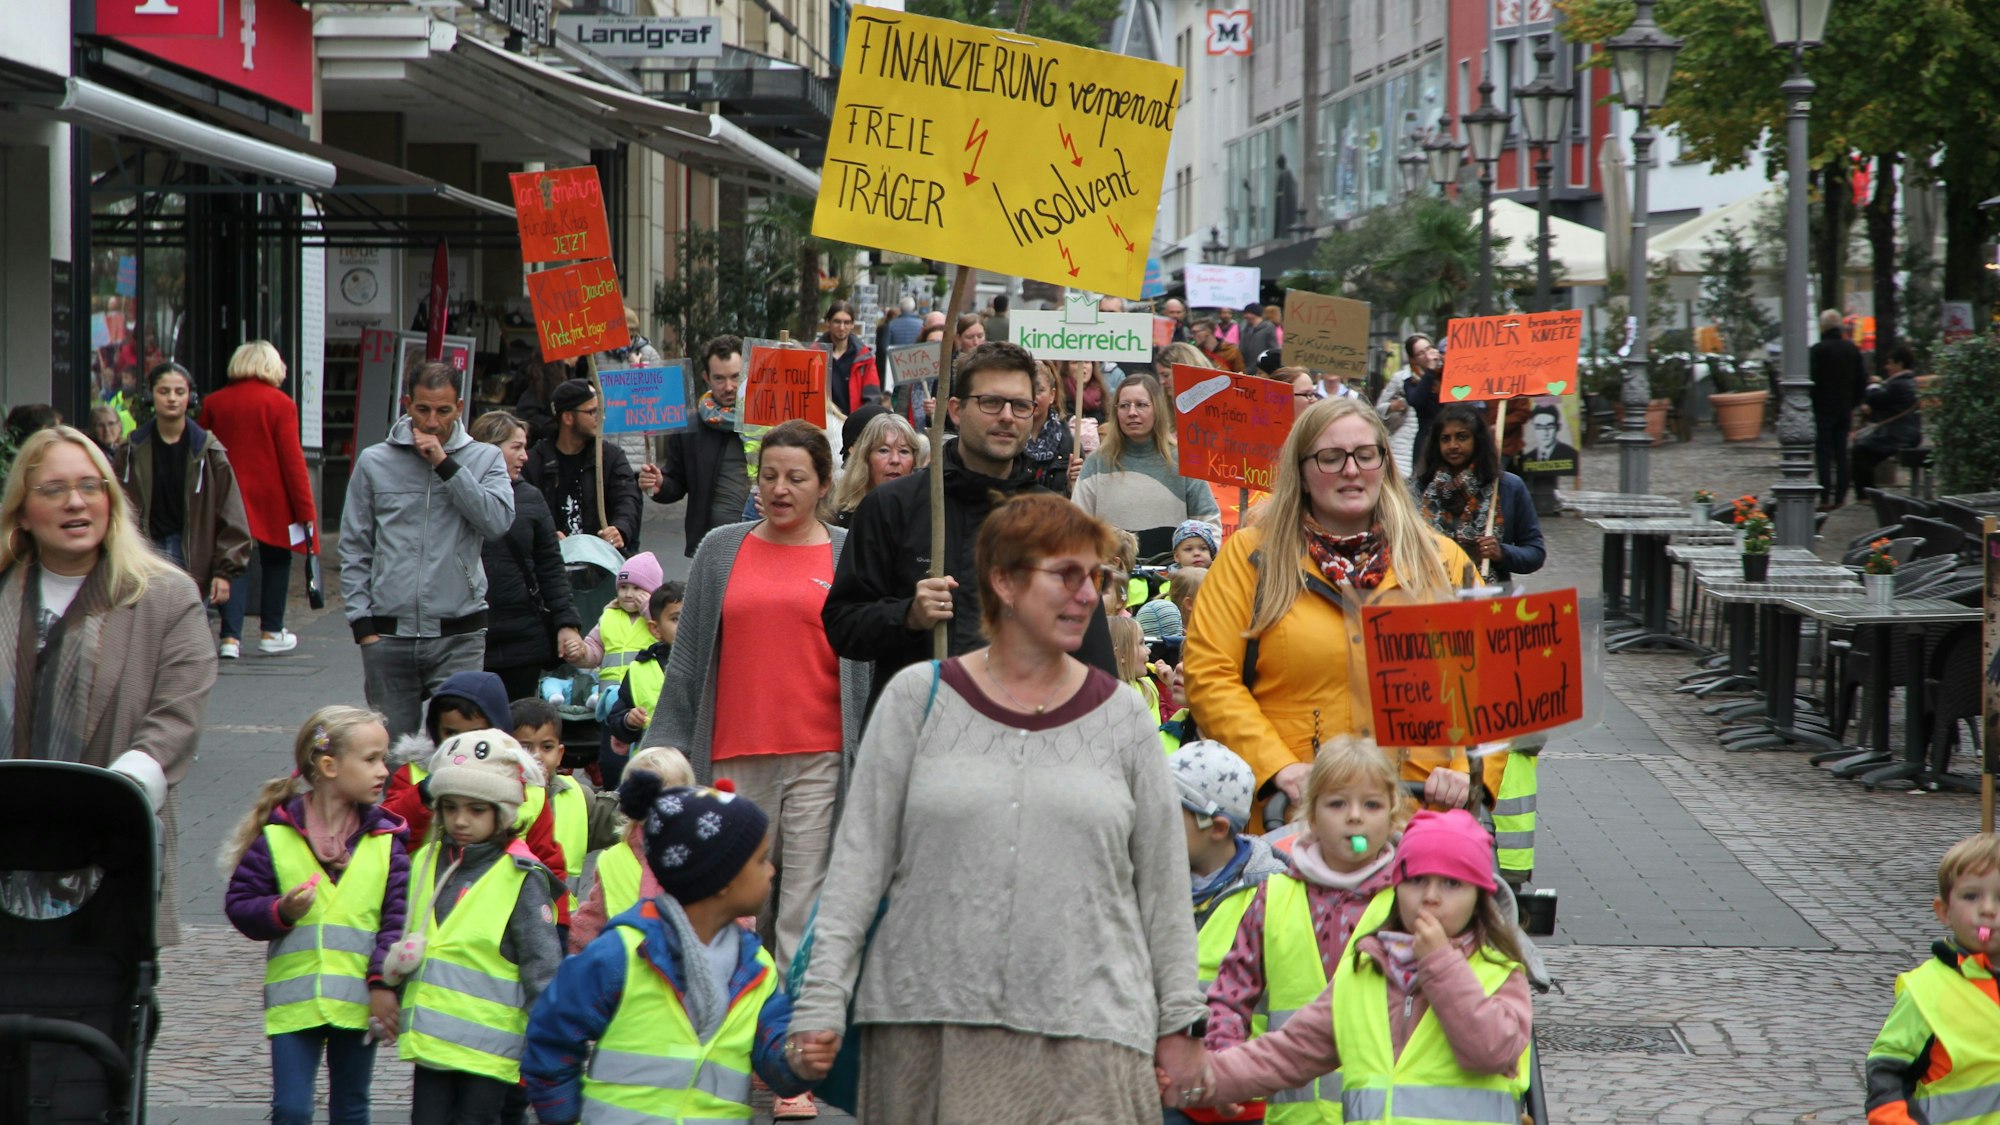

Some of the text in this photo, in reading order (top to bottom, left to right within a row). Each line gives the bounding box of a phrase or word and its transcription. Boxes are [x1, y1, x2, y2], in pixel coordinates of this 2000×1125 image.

[577, 25, 712, 48] Landgraf
[1217, 23, 1239, 42] M
[856, 16, 1179, 148] FINANZIERUNG verpennt
[845, 104, 934, 156] FREIE
[830, 158, 946, 228] TRÄGER
[992, 148, 1140, 247] Insolvent
[552, 231, 588, 255] JETZT
[335, 317, 382, 330] Landgraf
[1290, 301, 1337, 327] KITA
[1020, 326, 1147, 352] kinderreich
[1450, 319, 1520, 350] KINDER
[893, 349, 931, 366] KITA
[600, 371, 664, 388] FINANZIERUNG
[625, 404, 686, 426] INSOLVENT
[753, 389, 777, 420] KITA
[1207, 450, 1238, 479] Kita
[1369, 603, 1562, 672] Finanzierung verpennt
[1376, 668, 1433, 704] Freie
[1459, 662, 1570, 737] Insolvent
[1382, 708, 1445, 745] Träger
